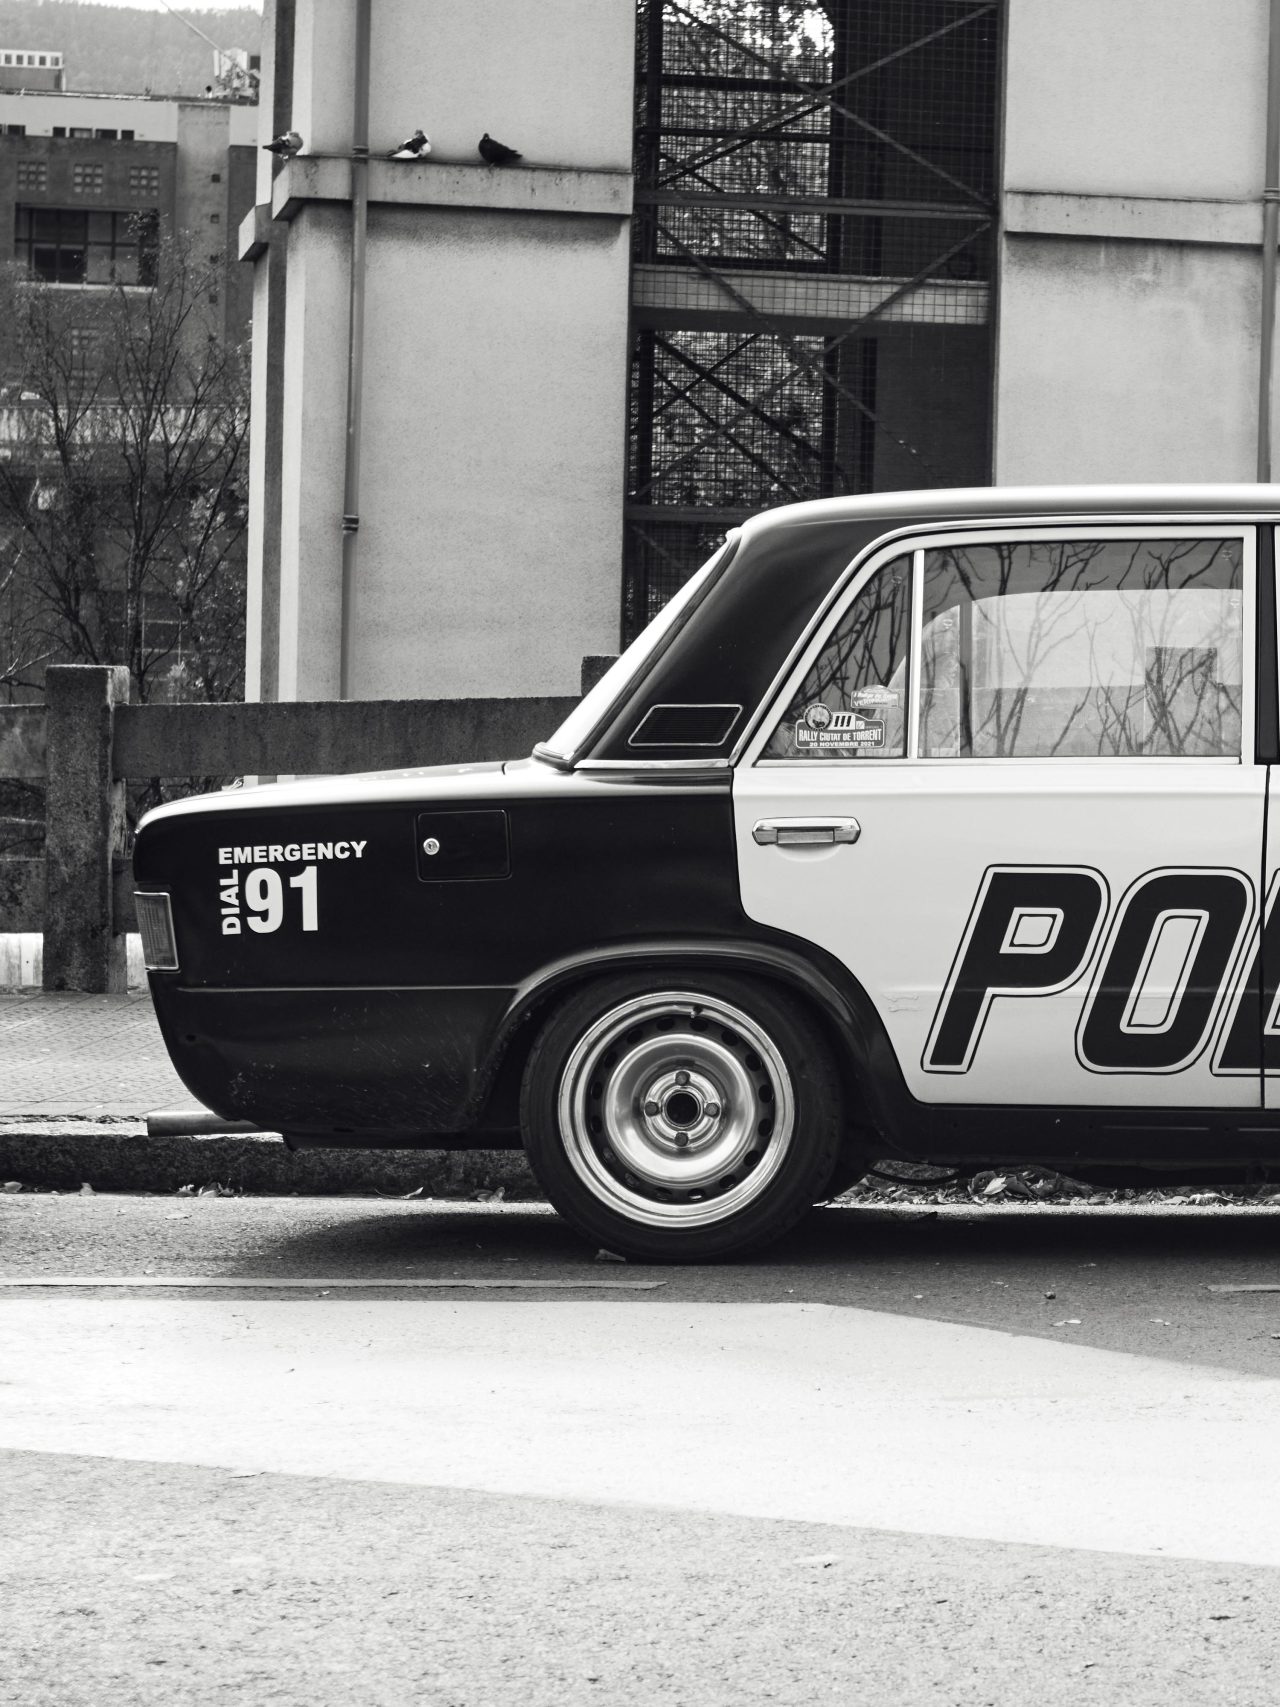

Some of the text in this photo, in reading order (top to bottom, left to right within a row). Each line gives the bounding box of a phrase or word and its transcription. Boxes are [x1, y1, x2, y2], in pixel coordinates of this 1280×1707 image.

[833, 715, 852, 727] III
[798, 729, 818, 742] RALLY
[842, 732, 852, 741] DE
[852, 729, 882, 741] TORRENT
[218, 840, 367, 864] EMERGENCY
[219, 869, 241, 935] DIAL
[245, 866, 318, 933] 91
